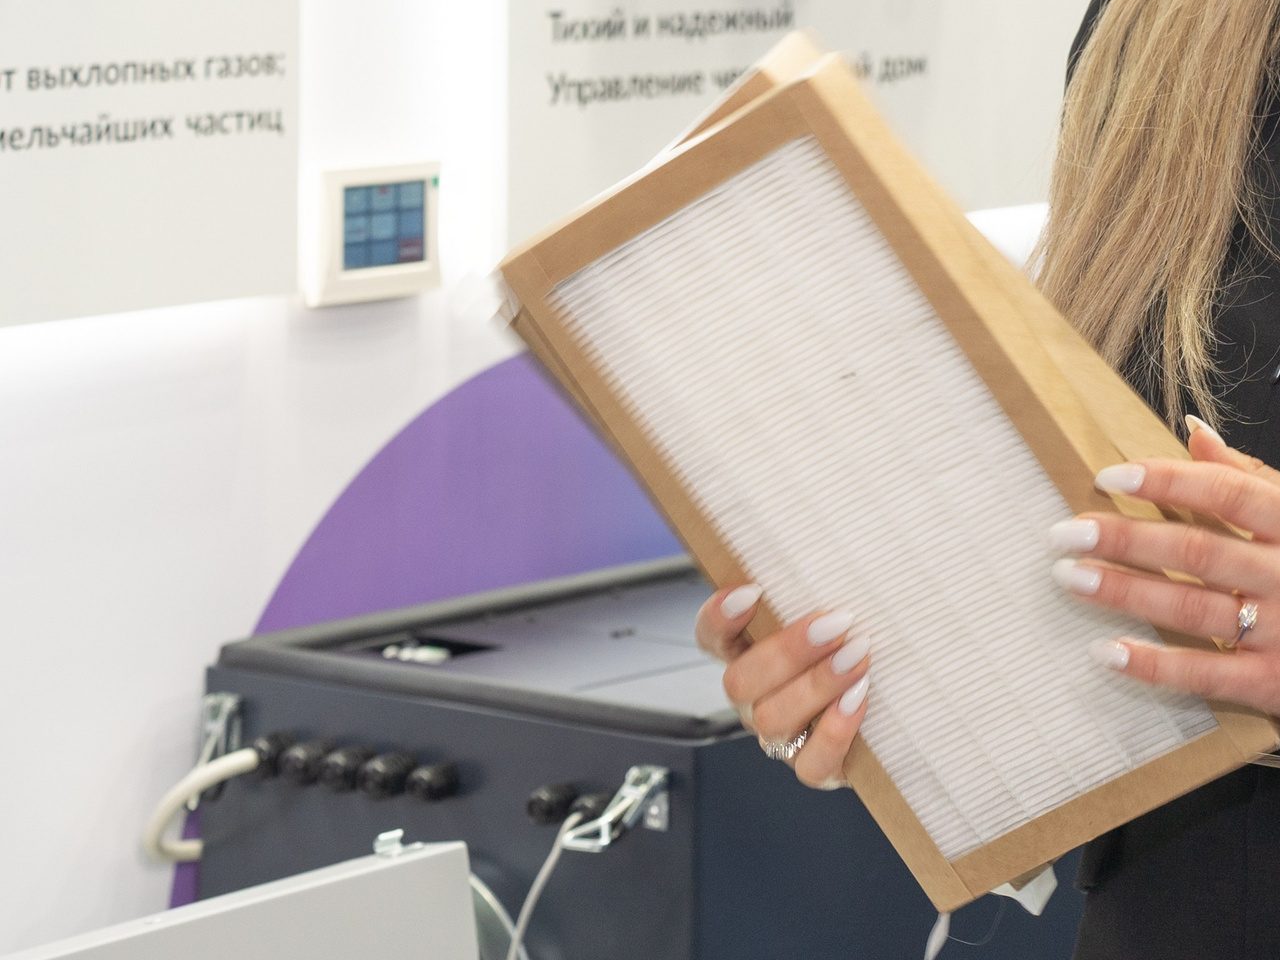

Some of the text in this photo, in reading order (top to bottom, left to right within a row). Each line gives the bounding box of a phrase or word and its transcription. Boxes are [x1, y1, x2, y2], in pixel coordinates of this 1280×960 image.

[549, 0, 795, 45] Тихий и надежный
[27, 58, 196, 91] выхлопных
[547, 70, 706, 106] Управление
[186, 109, 286, 138] частиц
